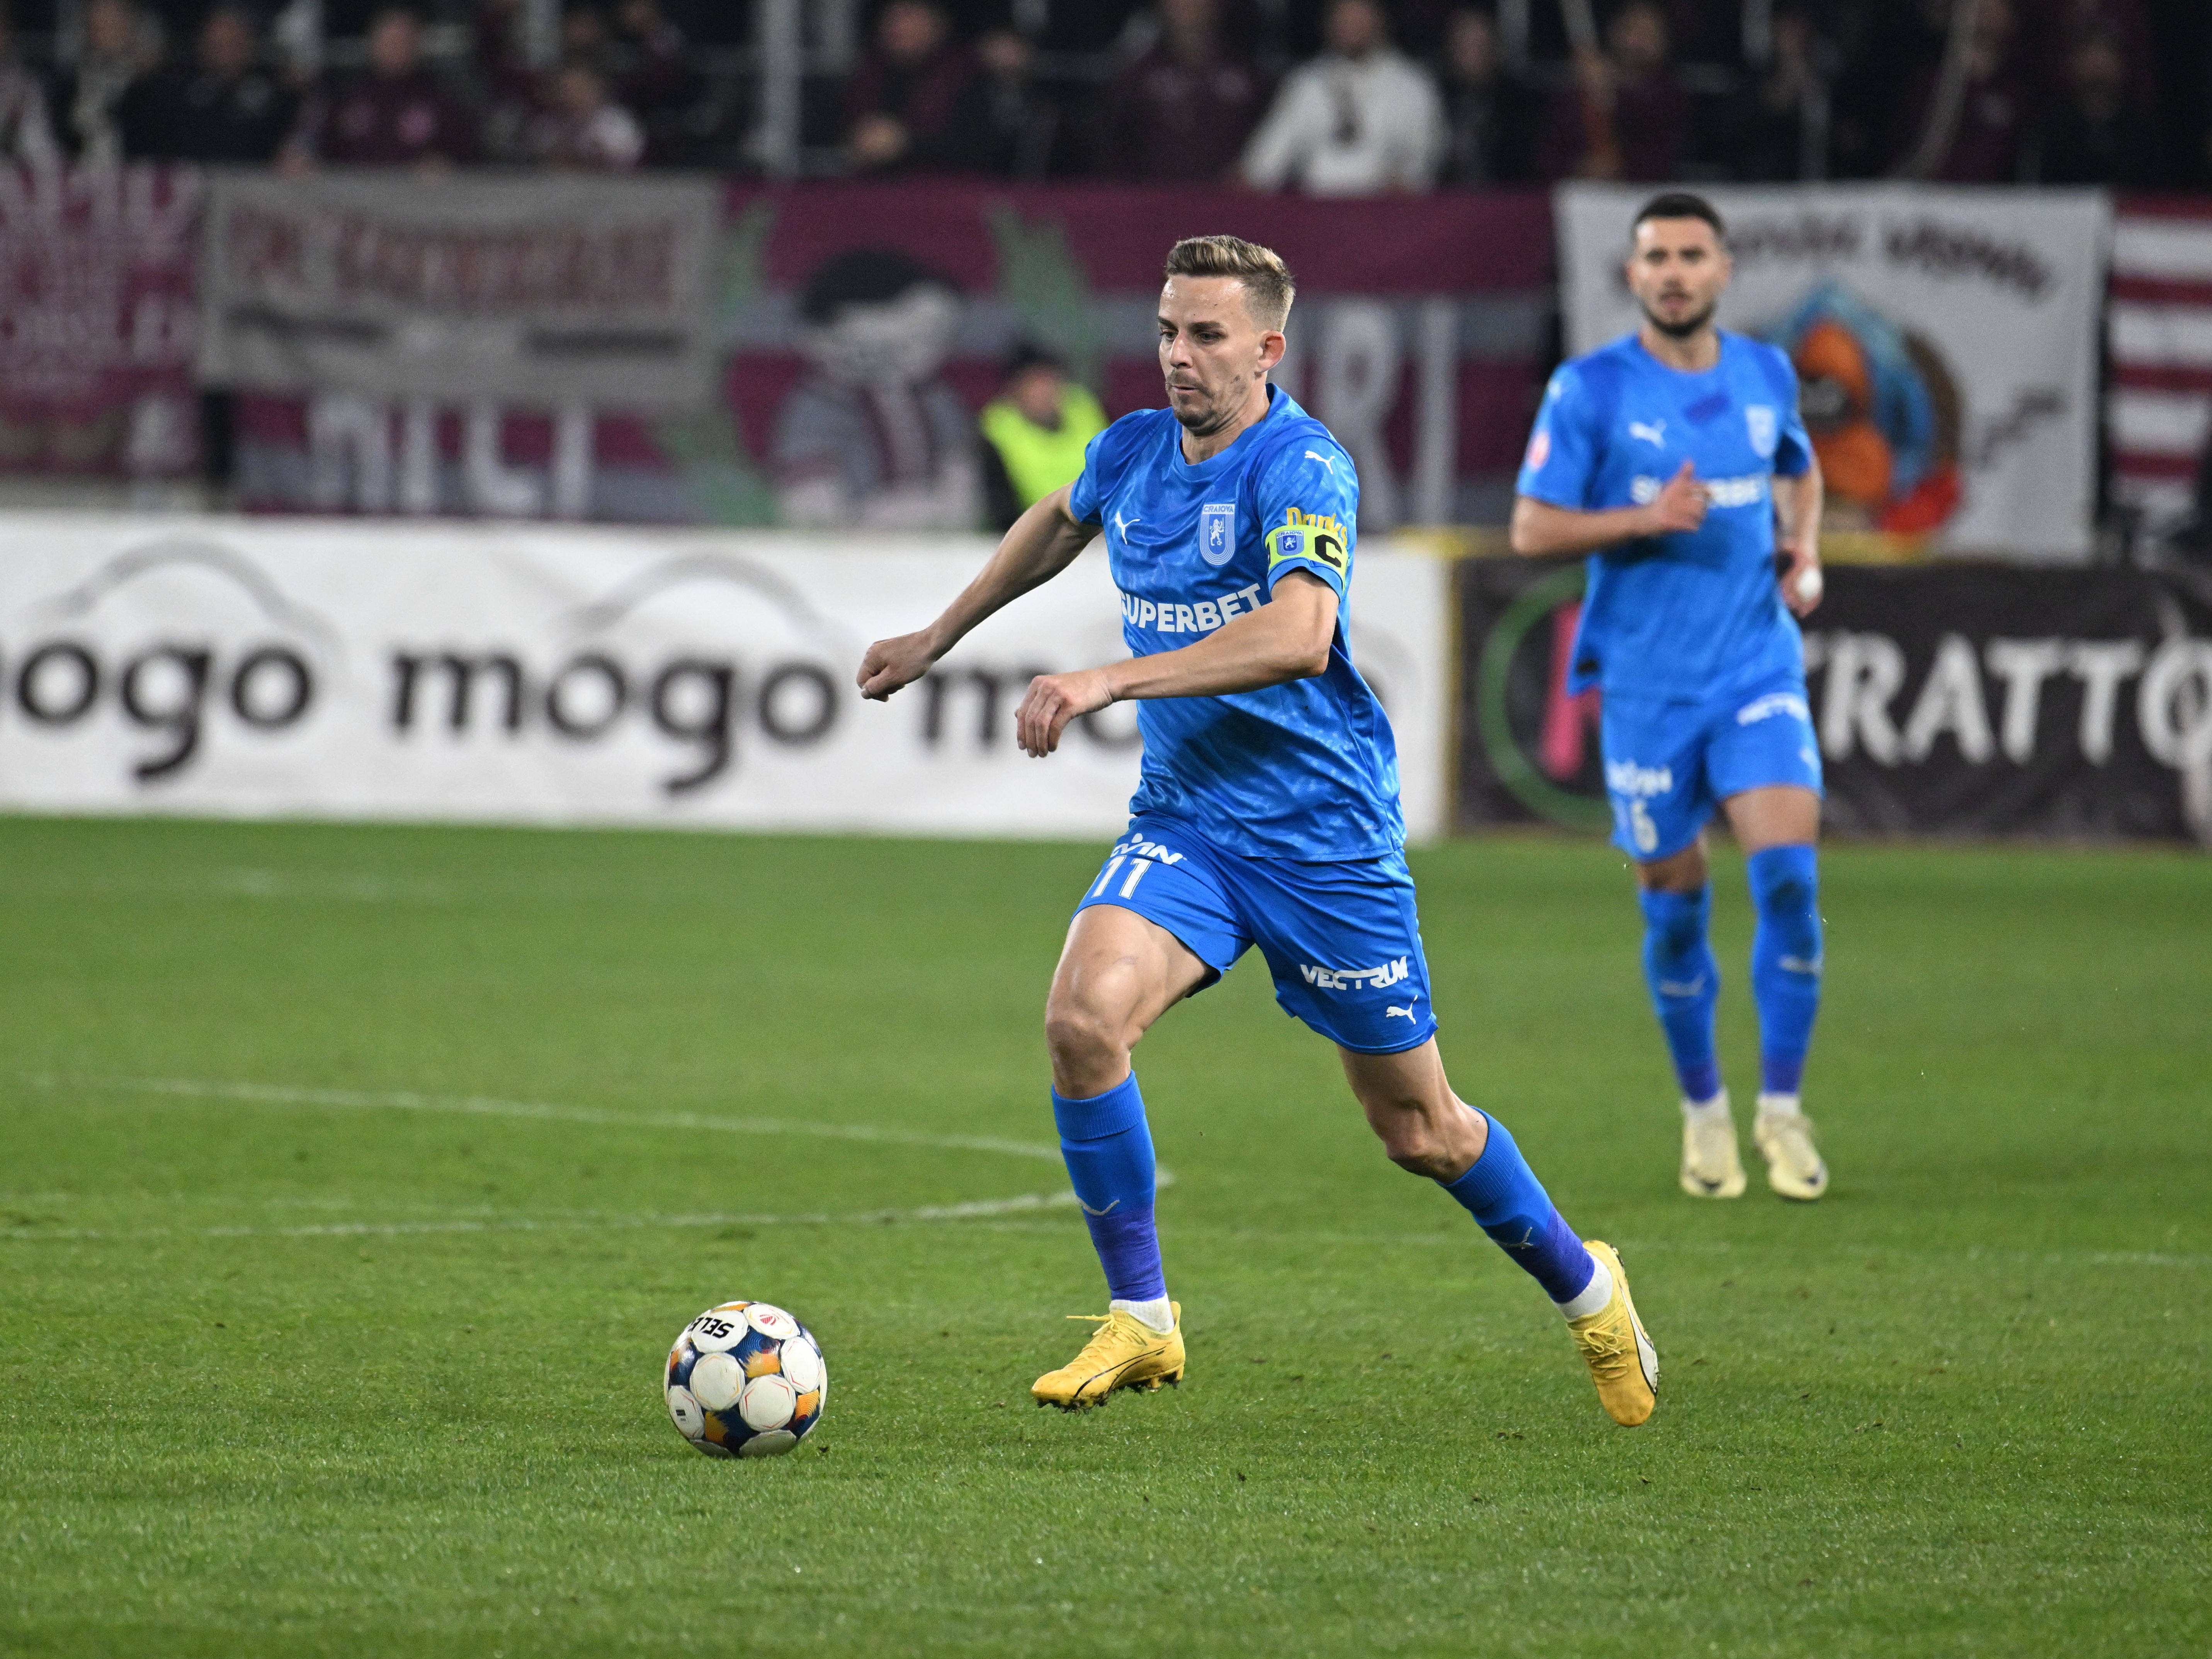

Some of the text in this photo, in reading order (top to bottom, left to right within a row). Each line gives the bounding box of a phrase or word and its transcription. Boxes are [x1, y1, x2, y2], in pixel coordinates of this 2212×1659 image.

[1314, 534, 1342, 568] C
[0, 639, 314, 784] ogo
[392, 647, 838, 800] mogo
[1804, 628, 2212, 769] RATTO
[1091, 855, 1153, 900] 11
[1300, 955, 1409, 990] VECTRUM
